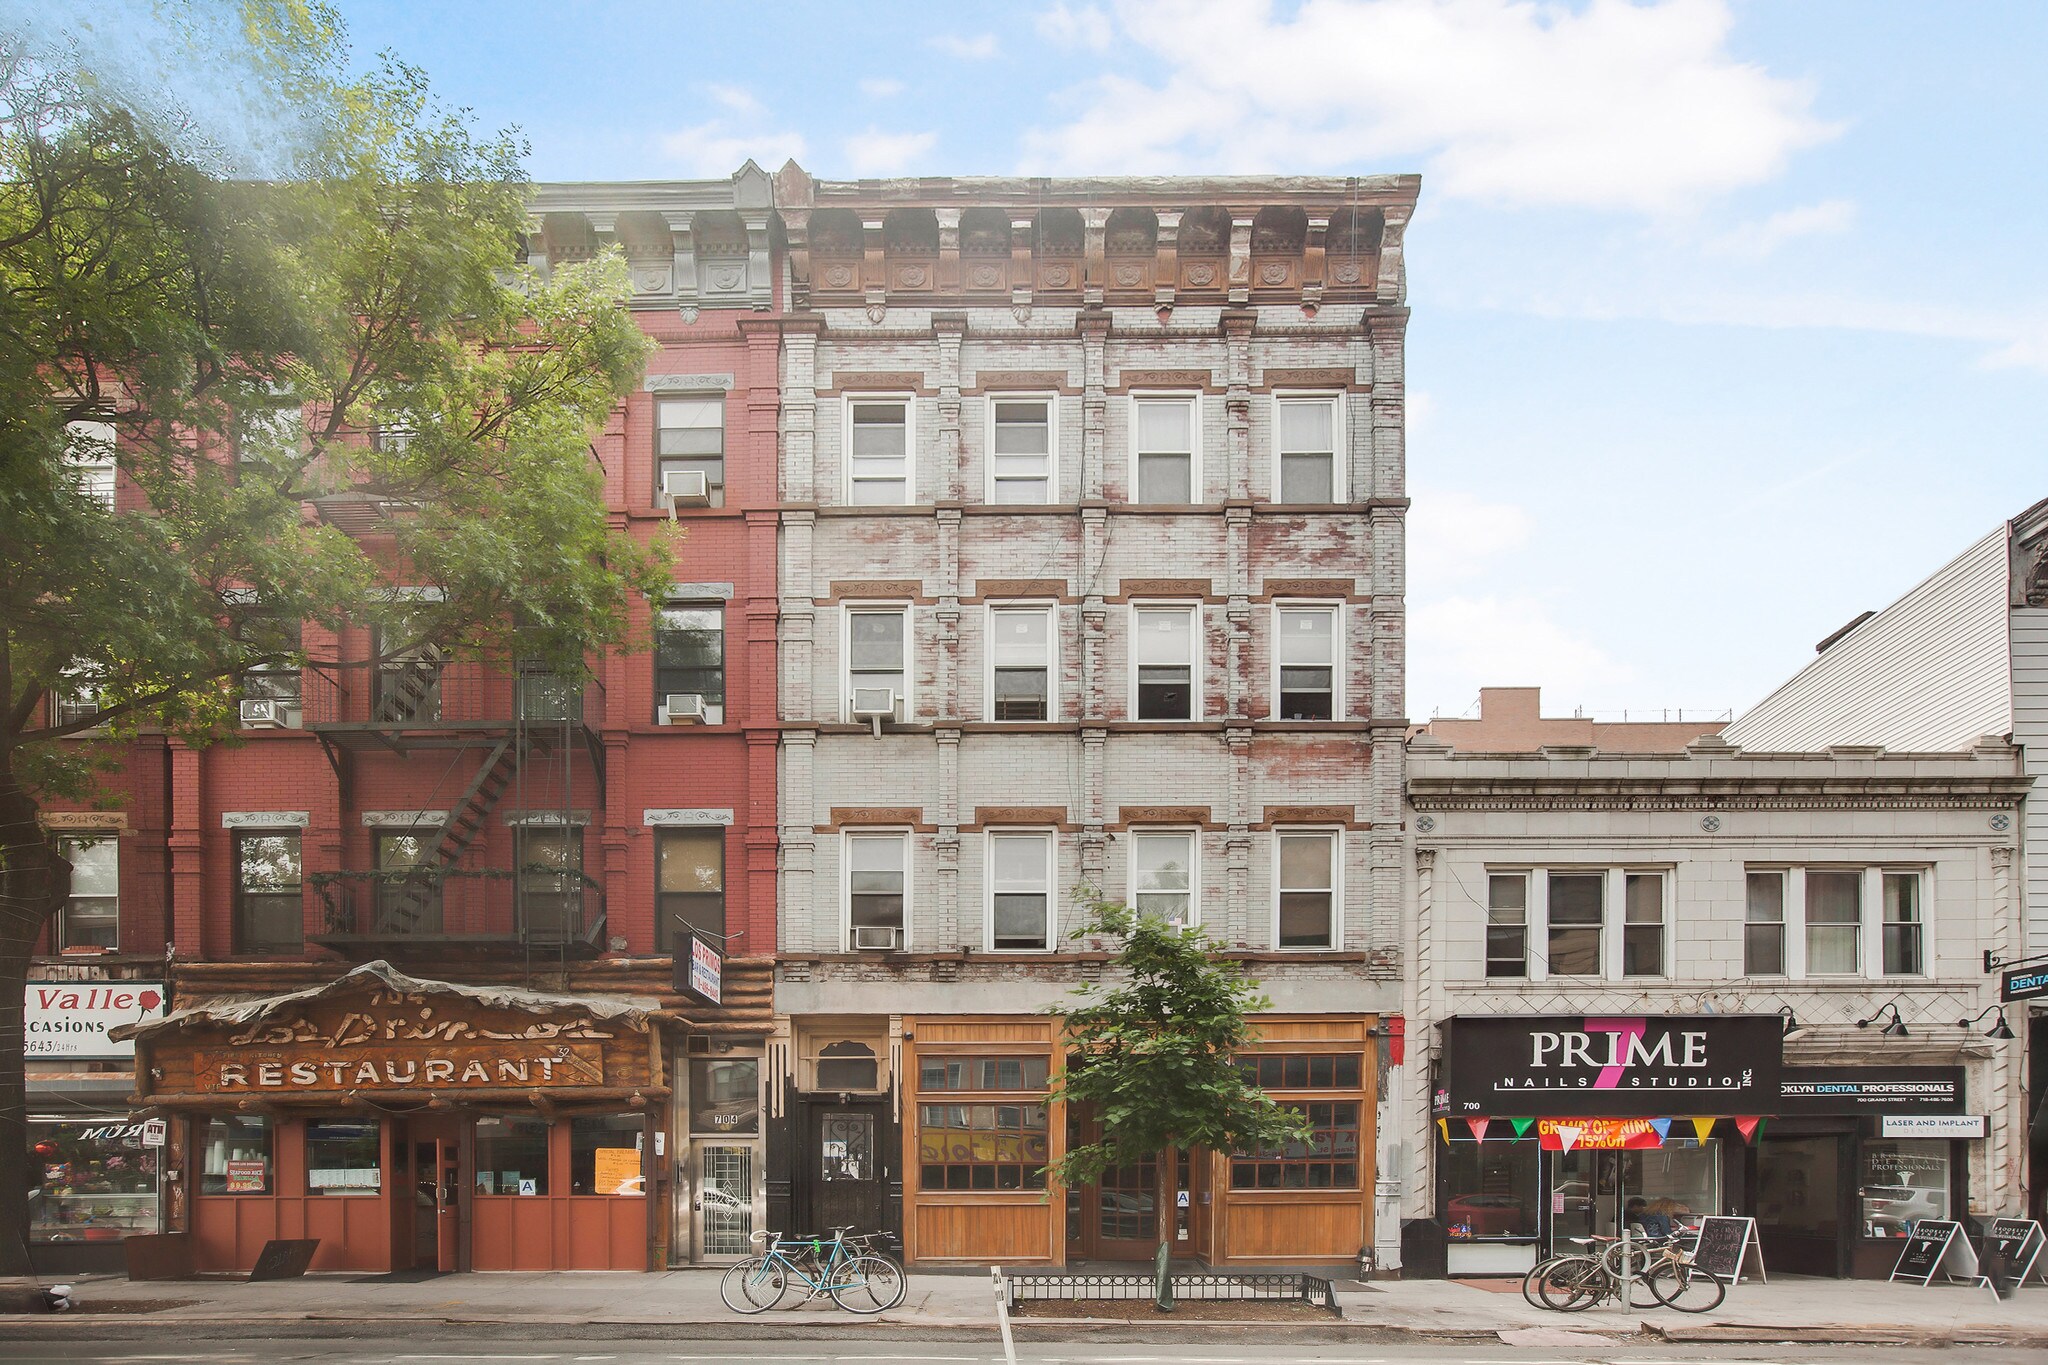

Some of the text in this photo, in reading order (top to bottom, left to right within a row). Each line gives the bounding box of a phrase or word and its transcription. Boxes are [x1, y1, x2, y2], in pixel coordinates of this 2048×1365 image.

[37, 989, 134, 1010] Valle
[1529, 1031, 1708, 1067] PRIME
[221, 1057, 563, 1086] RESTAURANT
[1504, 1076, 1733, 1087] NAILS STUDIO
[1742, 1068, 1752, 1087] INC.
[1817, 1084, 1860, 1093] DENTAL
[1862, 1084, 1955, 1093] PROFESSIONALS
[1463, 1102, 1481, 1110] 700
[714, 1115, 738, 1124] 704
[147, 1124, 164, 1134] ATM
[1592, 1119, 1655, 1134] OPNING
[522, 1181, 533, 1192] A
[1178, 1193, 1188, 1202] A
